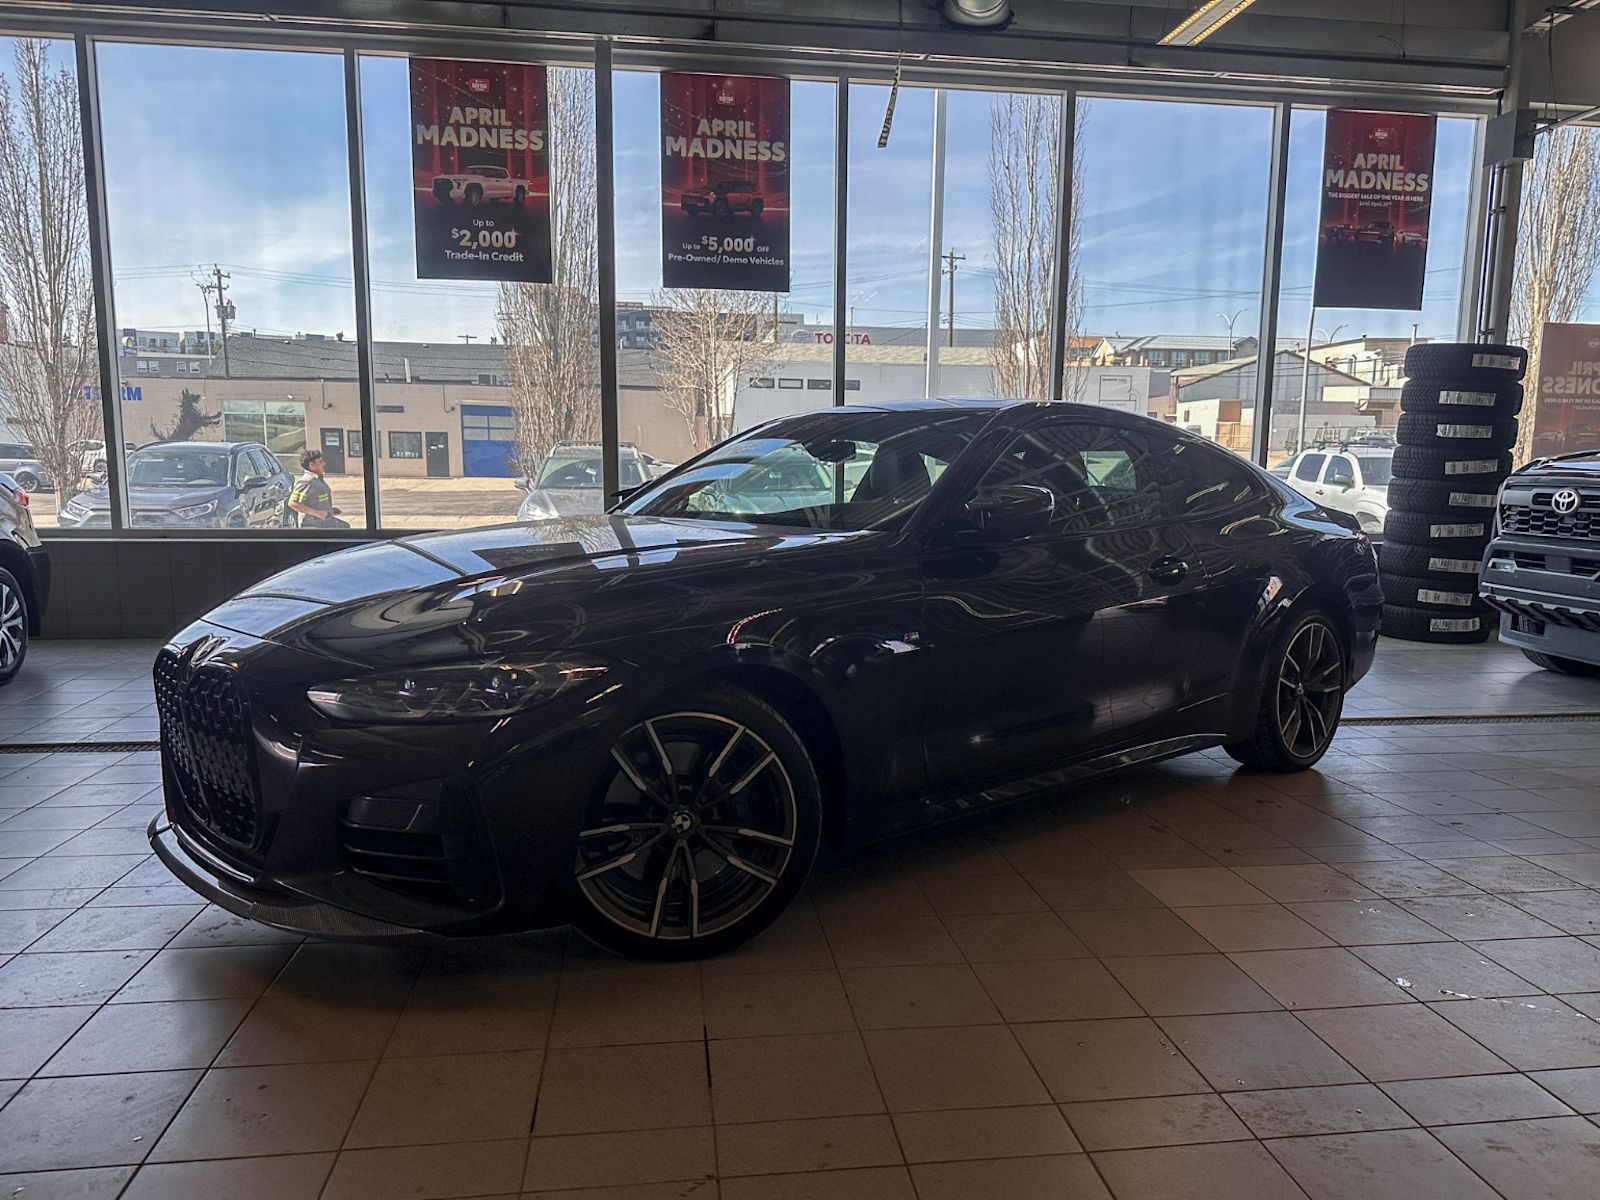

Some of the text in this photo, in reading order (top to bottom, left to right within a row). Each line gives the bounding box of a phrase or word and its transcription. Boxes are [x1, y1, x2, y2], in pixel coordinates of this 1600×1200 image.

[449, 106, 512, 127] APRIL
[416, 124, 544, 151] MADNESS
[696, 118, 756, 139] APRIL
[665, 135, 786, 162] MADNESS
[1353, 152, 1405, 171] APRIL
[1325, 168, 1429, 192] MADNESS
[472, 219, 494, 228] Up to
[451, 228, 516, 250] $2,000
[682, 242, 692, 251] Up
[701, 235, 754, 253] $5,000
[757, 245, 770, 253] OFF
[444, 250, 524, 262] Trade-In Credit
[722, 255, 748, 265] Demo
[749, 256, 784, 266] Vehicles
[815, 332, 871, 345] TOOTA
